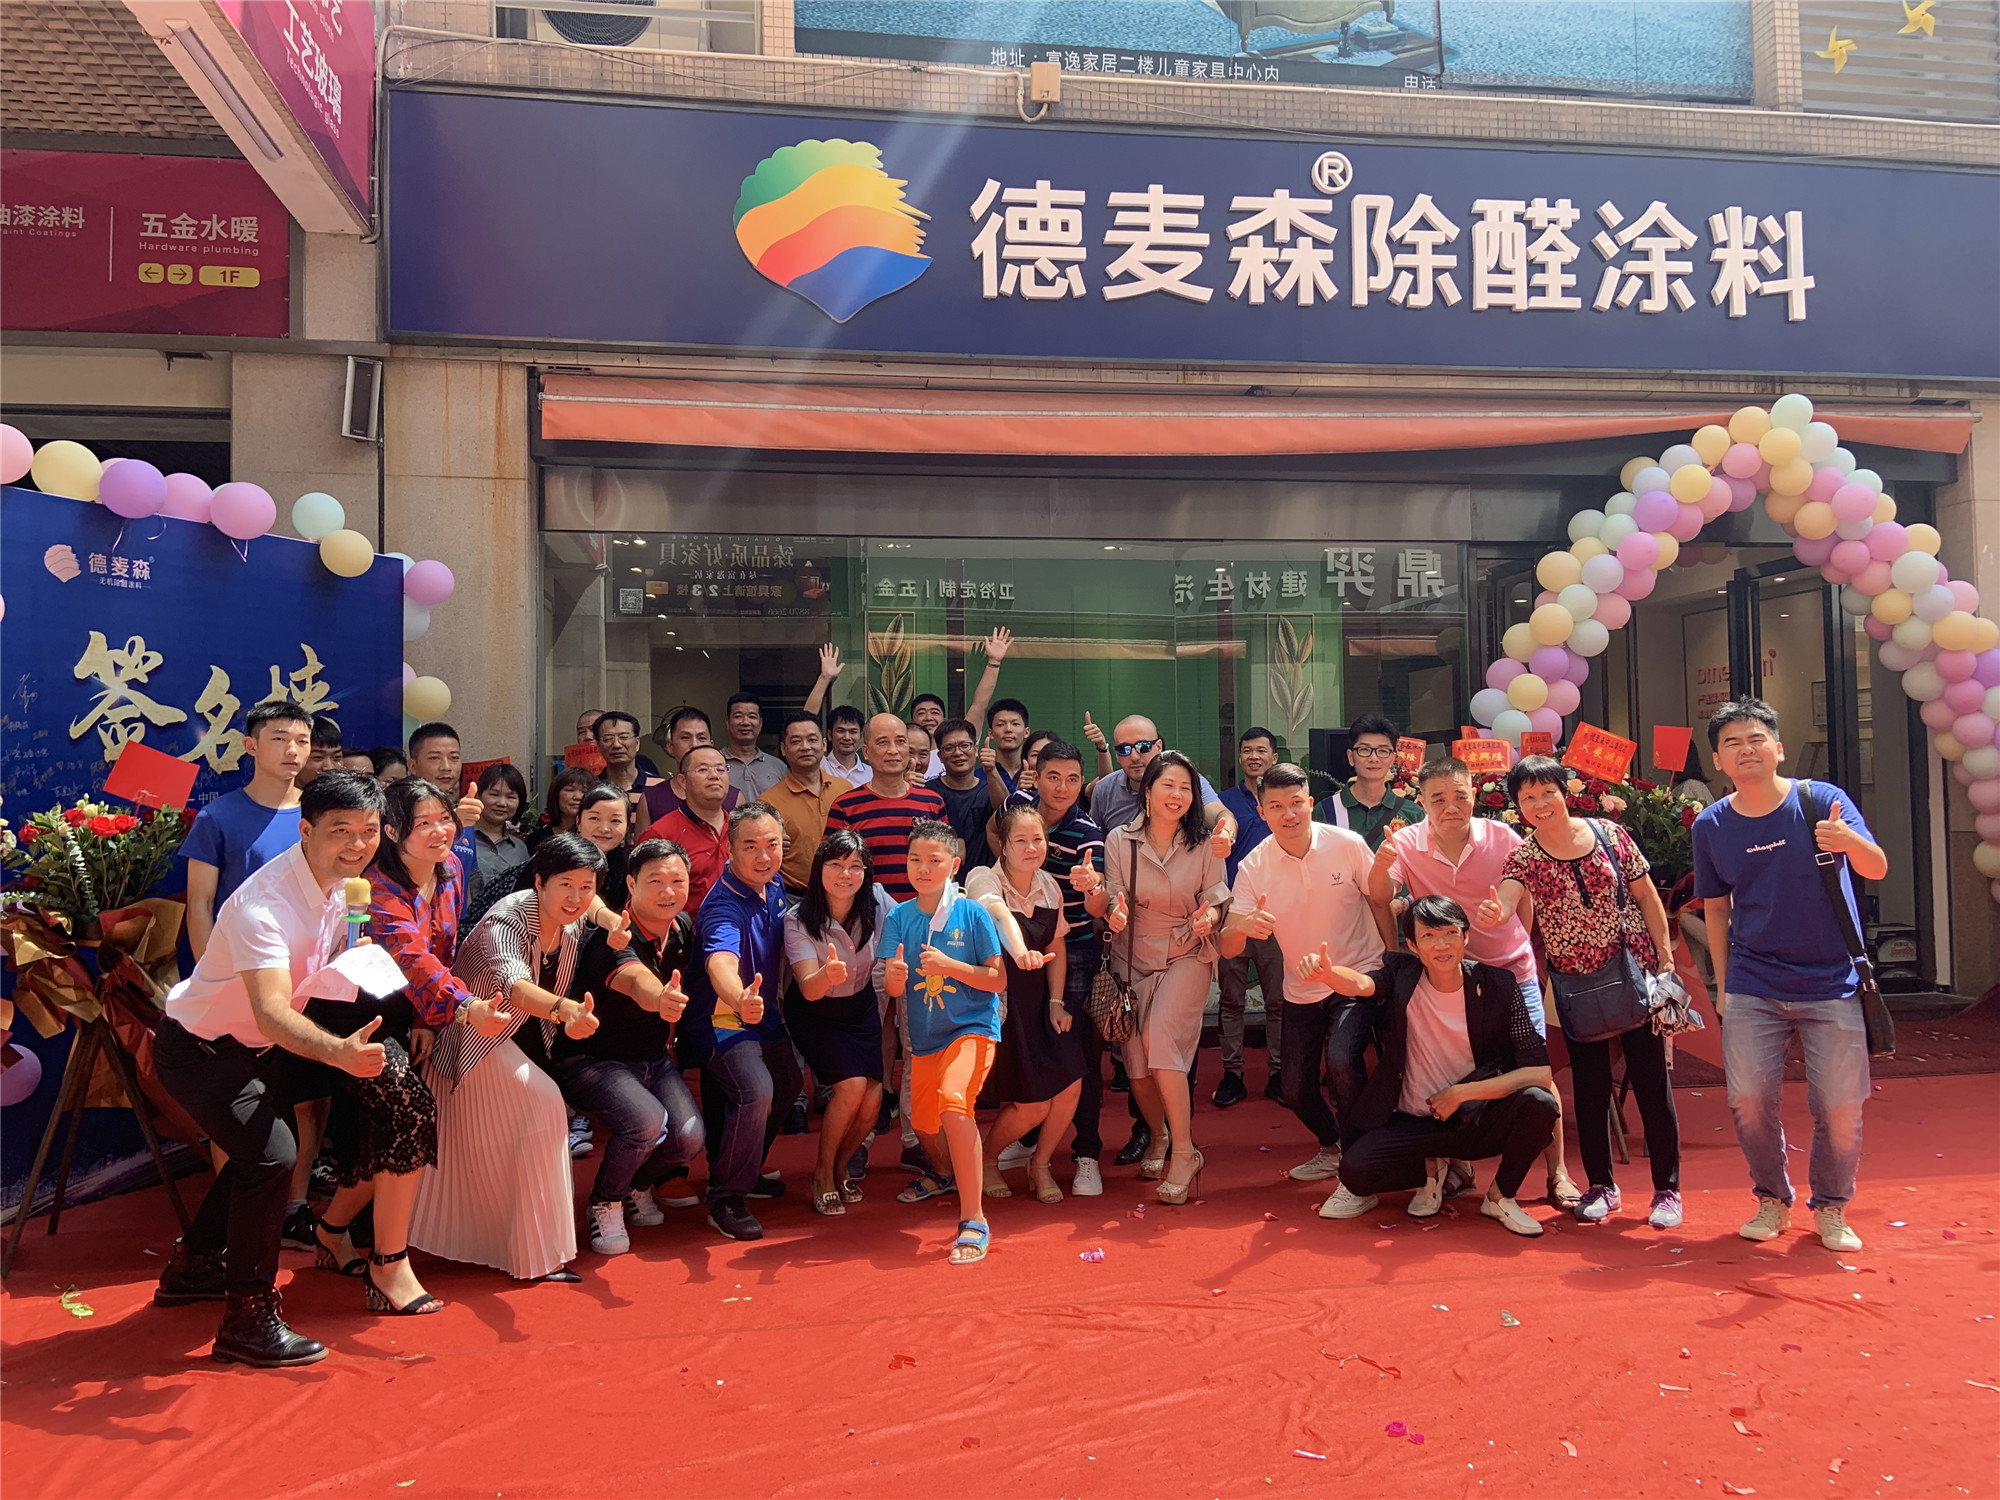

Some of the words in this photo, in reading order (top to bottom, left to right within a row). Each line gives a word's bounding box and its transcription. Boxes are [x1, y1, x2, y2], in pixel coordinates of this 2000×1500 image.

[283, 0, 342, 125] 工艺玻璃
[28, 228, 77, 239] Coatings
[139, 212, 260, 243] 五金水暖
[138, 241, 198, 253] Hardware
[202, 244, 260, 258] plumbing
[219, 270, 241, 284] 1F
